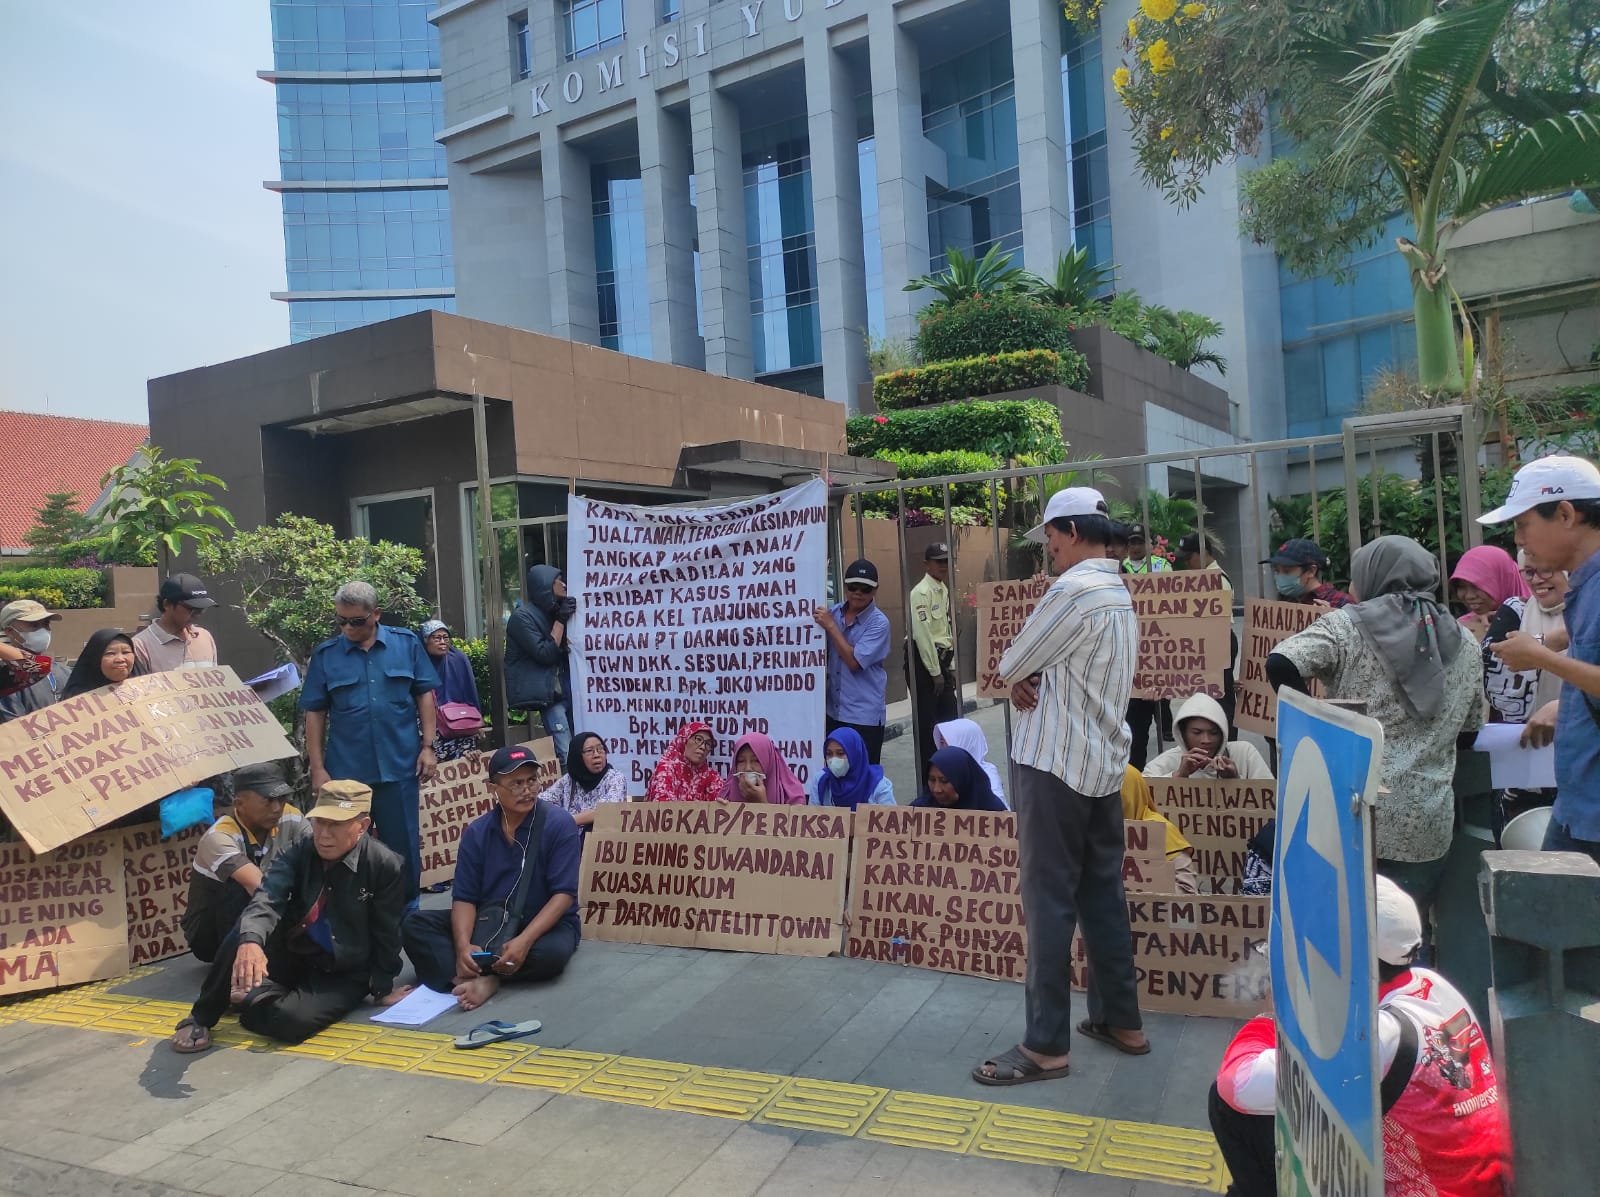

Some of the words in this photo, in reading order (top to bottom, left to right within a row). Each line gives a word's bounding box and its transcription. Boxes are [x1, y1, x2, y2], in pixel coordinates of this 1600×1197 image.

[531, 21, 708, 118] KOMISI
[741, 0, 846, 38] YU
[1541, 486, 1565, 496] FILA
[583, 549, 666, 568] TANGKAP
[585, 571, 633, 588] MAFIA
[638, 560, 744, 585] PERADILAN
[752, 556, 796, 576] YANG
[582, 587, 664, 608] TERLIBAT
[670, 584, 730, 605] KASUS
[737, 578, 797, 600] TANAH
[584, 609, 647, 629] WARGA
[653, 608, 685, 627] KEL
[1192, 597, 1224, 618] YG
[584, 632, 649, 651] DENGAN
[654, 631, 679, 650] PT
[683, 628, 738, 649] DARMO
[586, 655, 634, 674] TOWN
[715, 675, 751, 695] JOKO
[754, 672, 816, 693] WIDODO
[19, 692, 109, 740] KAMI
[182, 669, 227, 690] SIAP
[674, 699, 748, 716] POLHUKAM
[229, 707, 270, 727] DAN
[743, 717, 769, 735] MD
[594, 840, 627, 864] IBU
[632, 842, 689, 868] ENING
[693, 844, 835, 880] SUWANDARAI
[590, 870, 654, 894] KUASA
[657, 873, 735, 899] HUKUM
[584, 900, 610, 925] PT
[1129, 900, 1265, 929] KEMBALI
[849, 937, 925, 965] DARMO
[939, 923, 1025, 957] PUNYA
